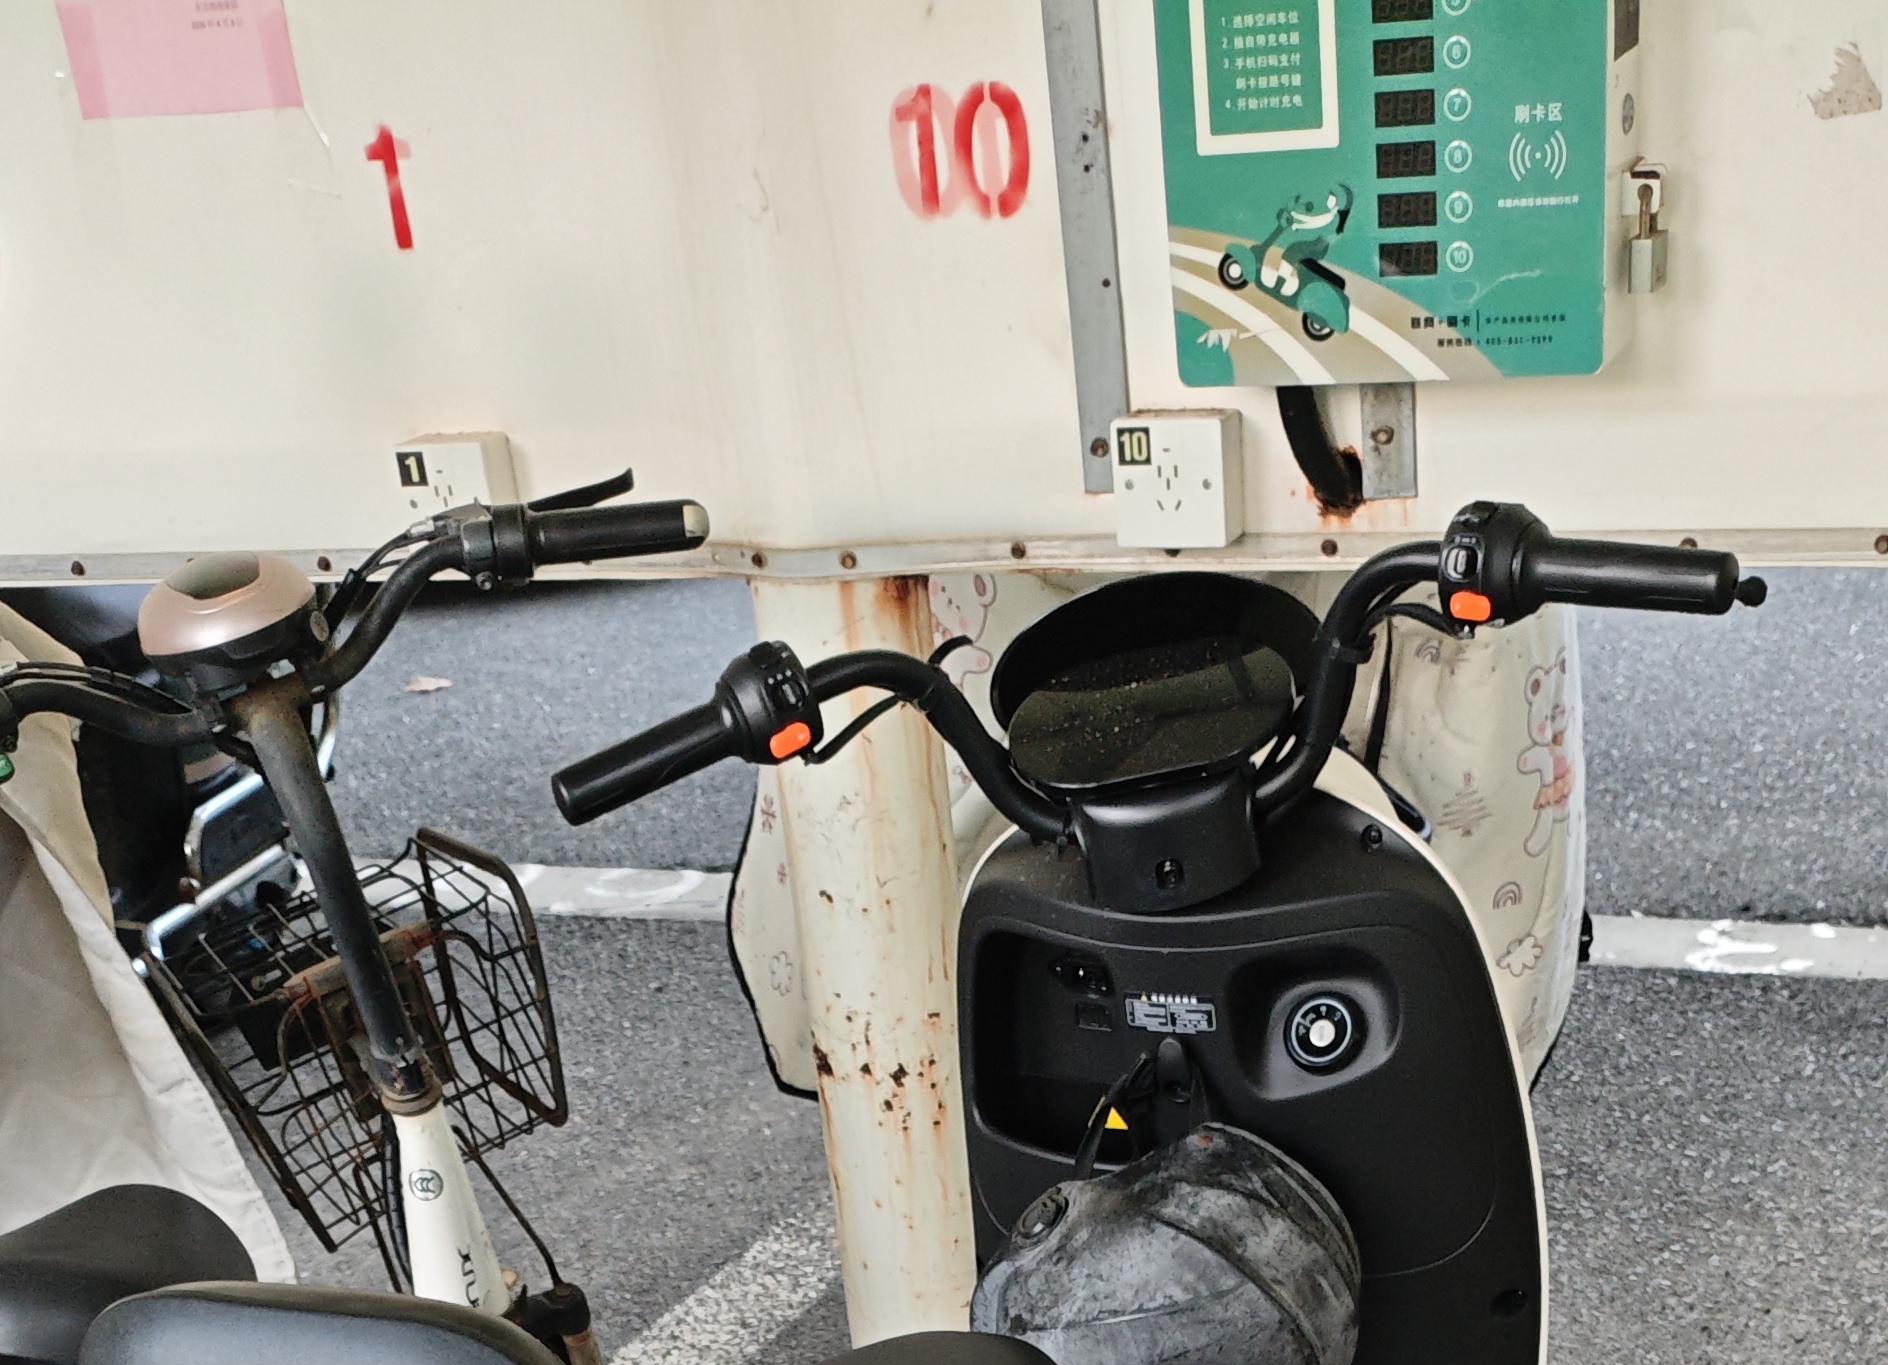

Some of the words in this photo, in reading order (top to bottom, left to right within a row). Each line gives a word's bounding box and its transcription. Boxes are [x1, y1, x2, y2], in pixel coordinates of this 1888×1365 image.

[1514, 102, 1563, 124] 刷卡区
[893, 81, 1030, 219] 10
[366, 127, 413, 250] 1
[1453, 248, 1467, 264] 10
[1119, 431, 1147, 462] 10
[404, 456, 420, 482] 1
